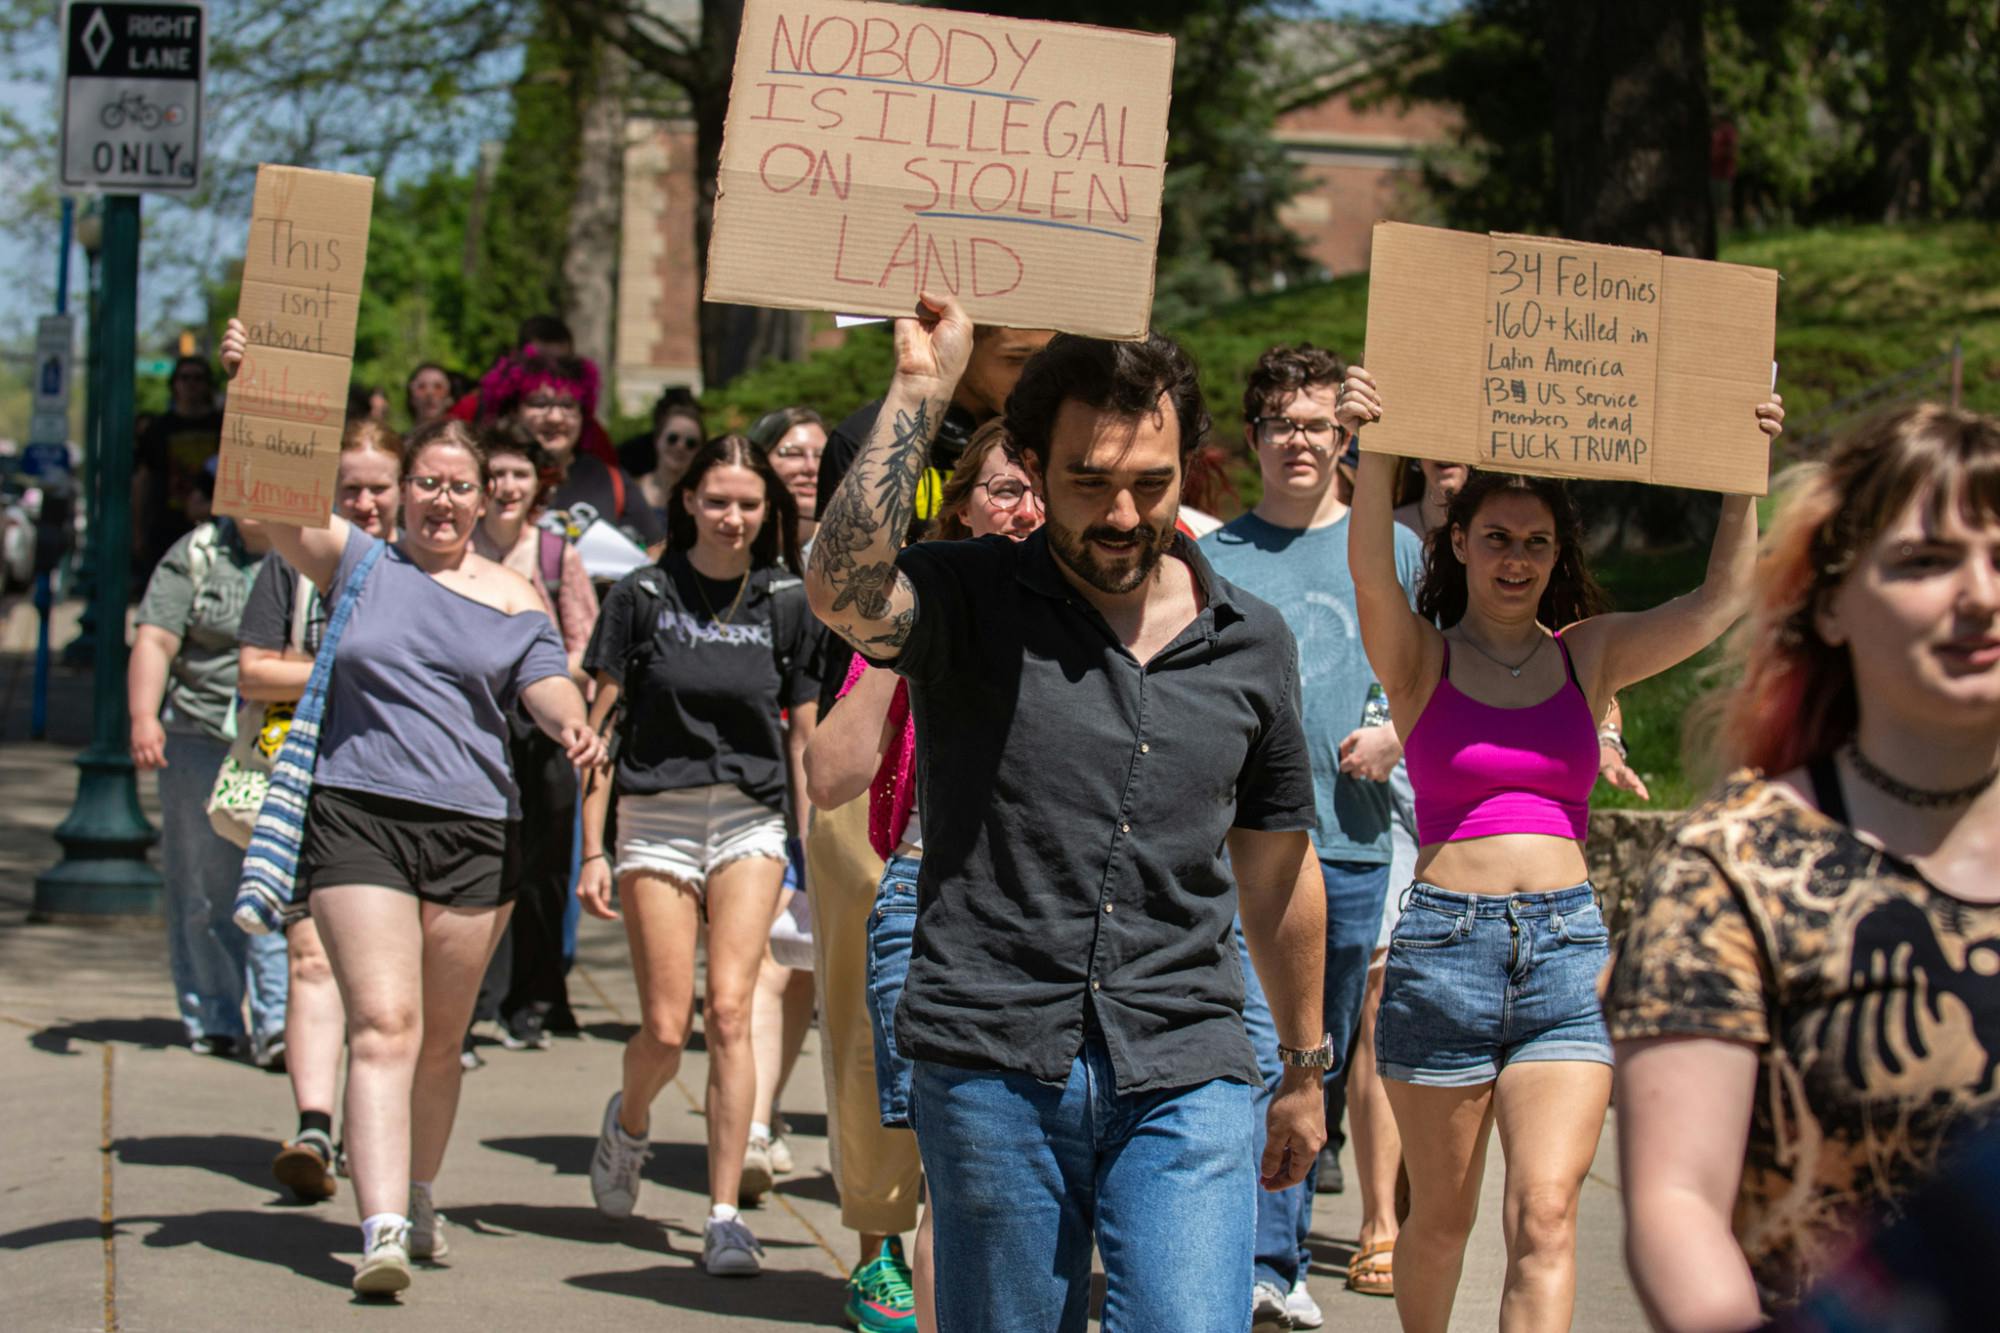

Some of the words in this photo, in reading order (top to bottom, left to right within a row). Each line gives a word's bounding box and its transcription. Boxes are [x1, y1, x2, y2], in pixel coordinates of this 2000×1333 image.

[127, 14, 197, 40] RIGHT
[128, 46, 191, 71] LANE
[770, 14, 1042, 92] NOBODY
[750, 82, 848, 130] IS
[854, 89, 1157, 169] ILLEGAL
[93, 140, 184, 176] ONLY
[758, 142, 853, 201] ON
[902, 156, 1130, 225] STOLEN
[256, 217, 342, 272] This
[833, 213, 1024, 297] LAND
[1557, 255, 1657, 304] Felonies
[280, 281, 337, 319] isn't
[248, 321, 329, 353] about
[1631, 326, 1649, 344] in
[1487, 343, 1534, 371] Latin
[1544, 346, 1625, 377] America
[238, 353, 330, 420] Politics
[1537, 381, 1567, 406] US
[1491, 408, 1569, 429] members
[1586, 411, 1633, 436] dead
[265, 428, 321, 459] about
[1490, 430, 1561, 461] FUCK
[1570, 434, 1648, 465] TRUMP
